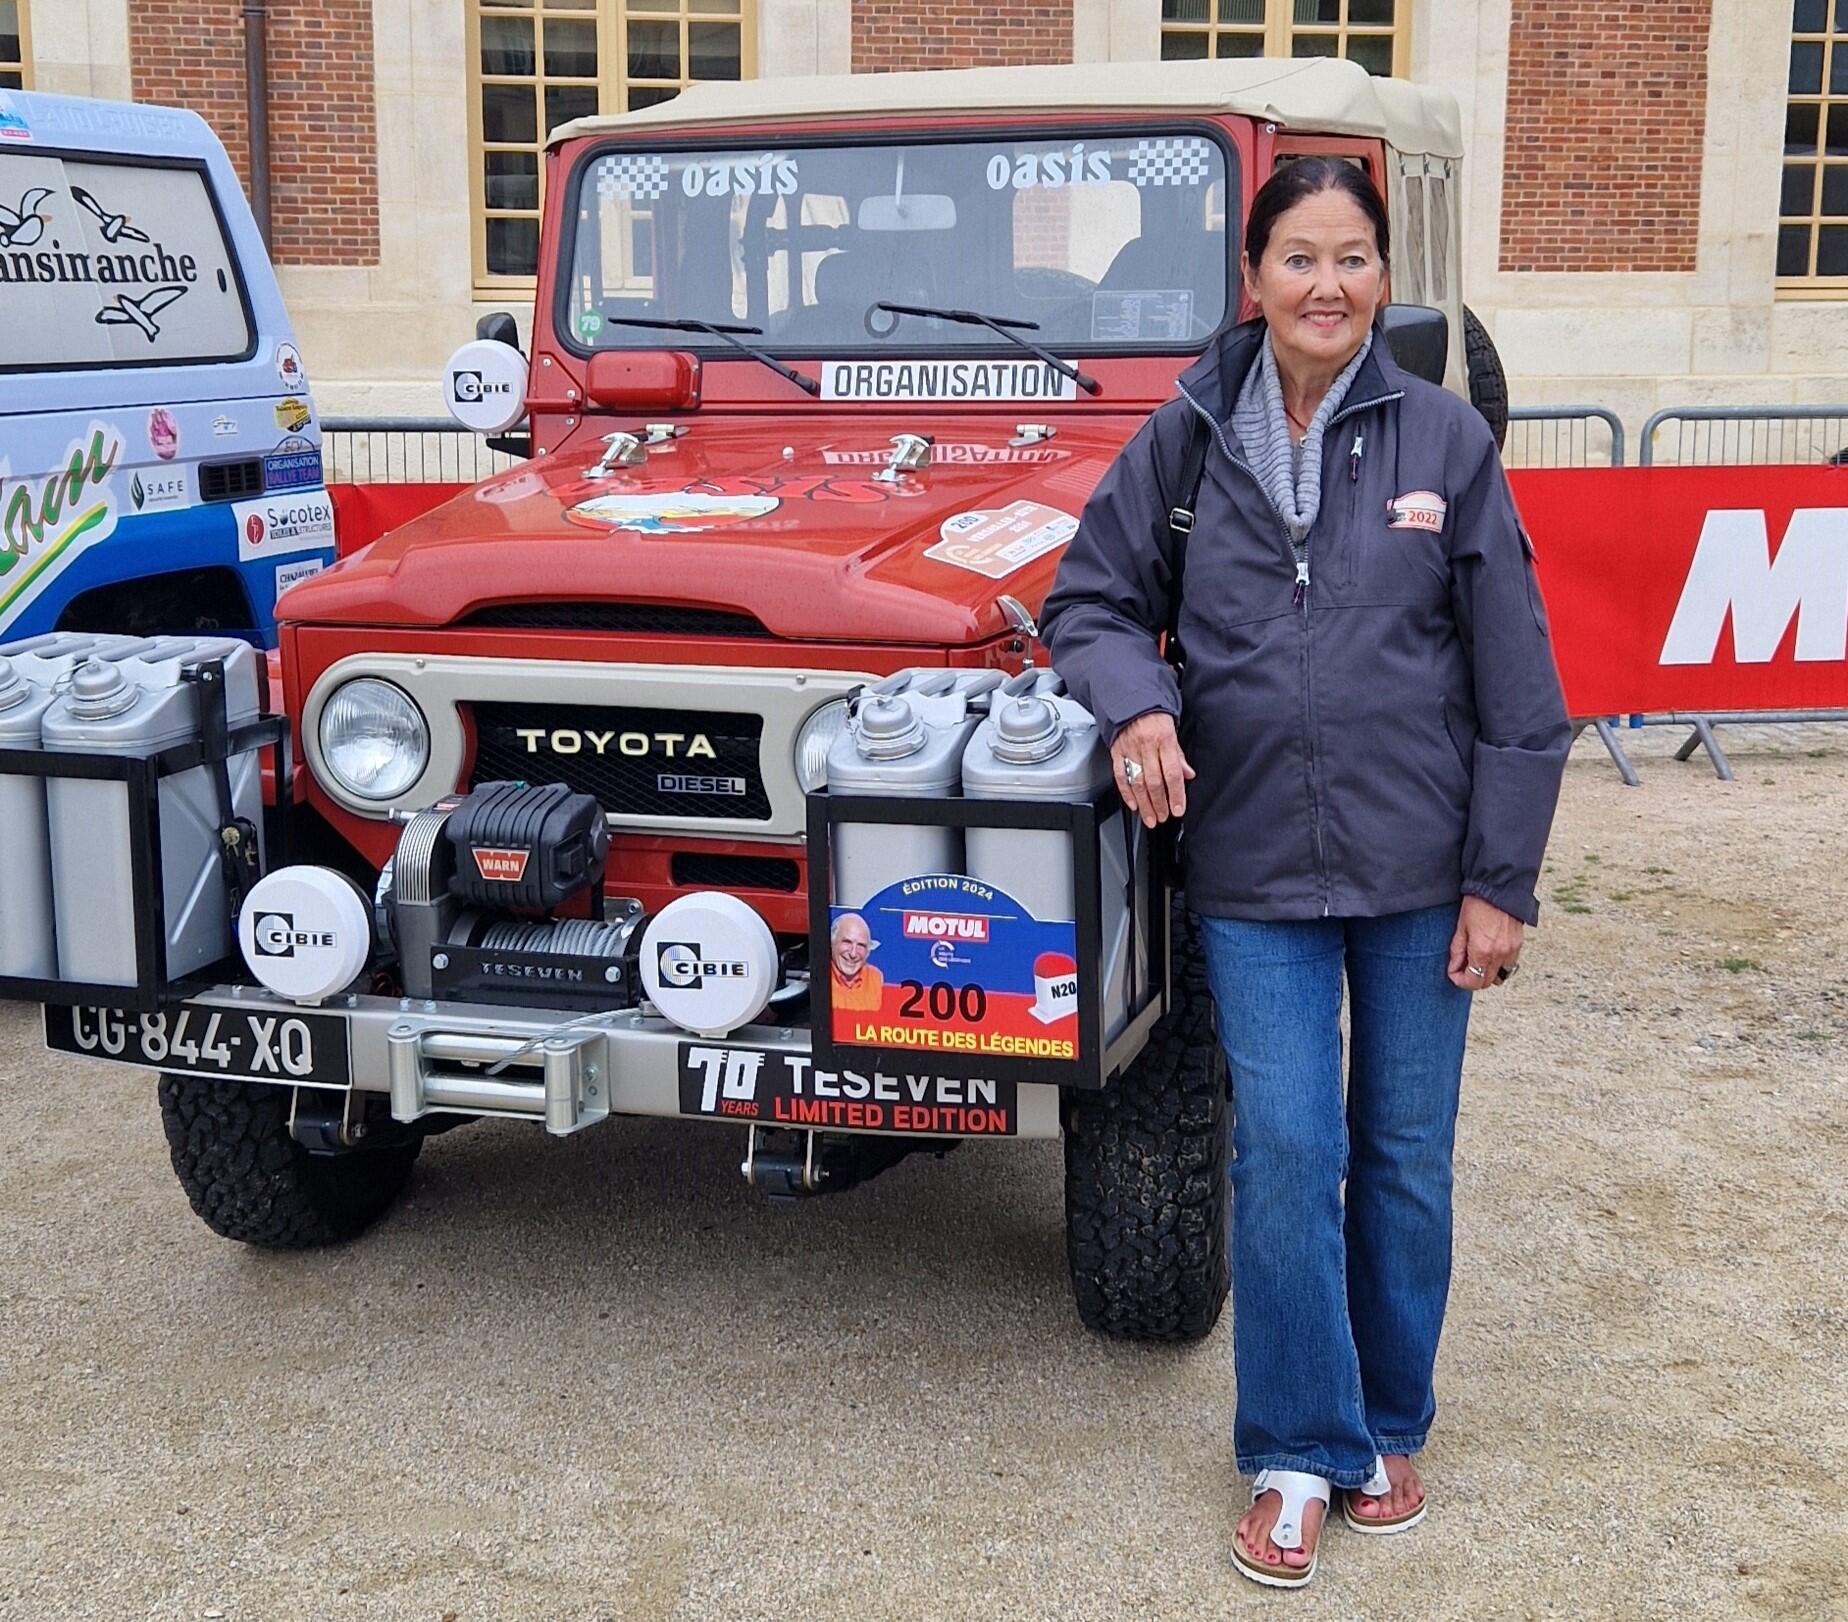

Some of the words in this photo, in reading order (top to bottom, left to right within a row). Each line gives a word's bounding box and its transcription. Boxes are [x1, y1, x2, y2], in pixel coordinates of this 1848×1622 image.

[682, 153, 798, 197] oasis
[986, 143, 1111, 189] oasis
[465, 384, 510, 393] CIBIE
[834, 364, 1064, 396] ORGANISATION
[267, 455, 319, 471] ORGANISATION
[147, 480, 184, 495] SAFE
[1408, 510, 1437, 525] 2022
[516, 728, 717, 758] TOYOTA
[660, 775, 744, 794] DIESEL
[482, 858, 520, 872] WARN
[903, 878, 958, 896] ÉDITION
[962, 881, 993, 901] 2024
[907, 915, 986, 938] MOTUL
[270, 931, 334, 946] CIBIE
[481, 962, 583, 981] TESEVEN
[674, 961, 745, 977] CIBIE
[900, 979, 987, 1023] 200
[855, 1023, 877, 1042] LA
[880, 1026, 936, 1047] ROUTE
[942, 1031, 976, 1050] DES
[980, 1031, 1073, 1058] LÉGENDES
[784, 1056, 996, 1104] TESEVEN
[720, 1099, 759, 1116] YEARS
[774, 1097, 883, 1127] LIMITED
[893, 1105, 1007, 1132] EDITION
